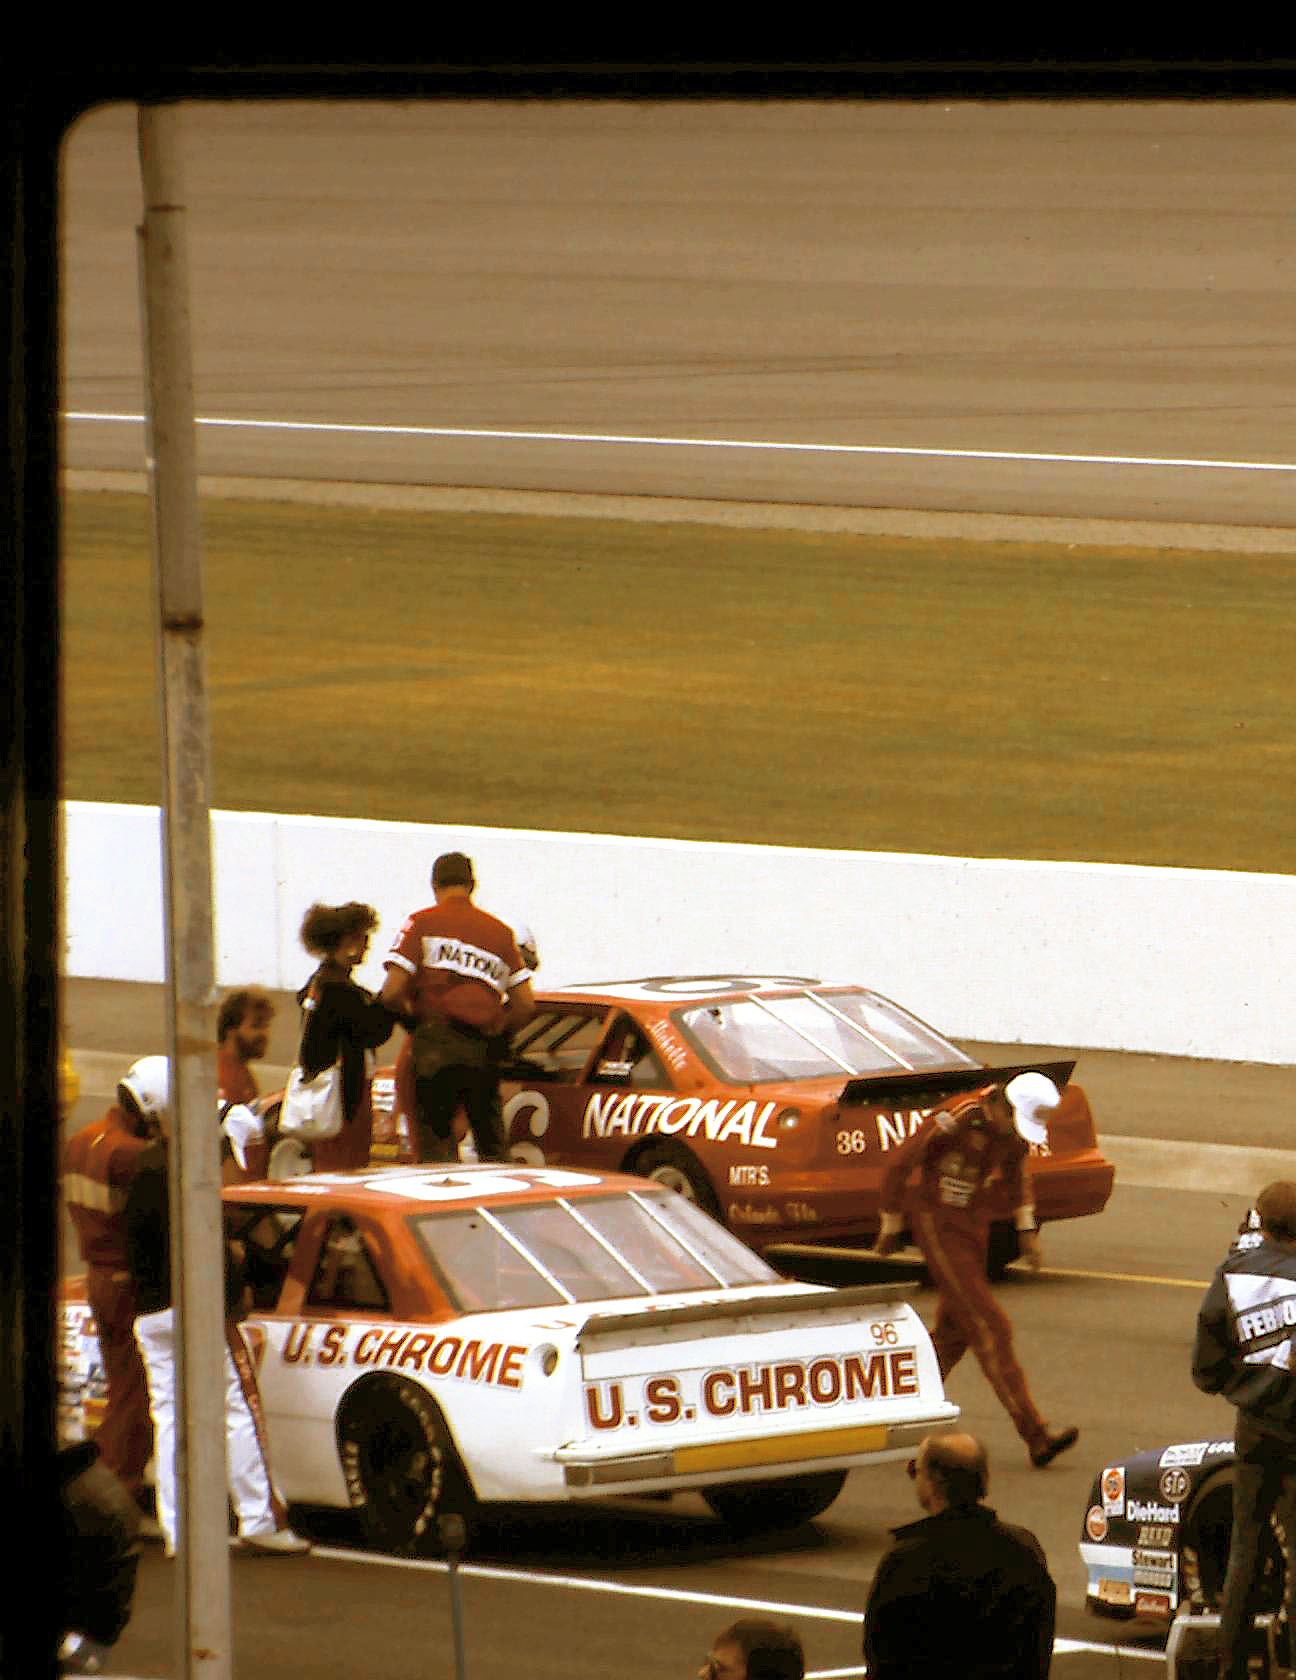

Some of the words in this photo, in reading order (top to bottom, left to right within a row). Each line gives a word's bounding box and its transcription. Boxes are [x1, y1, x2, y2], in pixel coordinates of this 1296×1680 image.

[583, 1093, 778, 1148] NATIONAL
[836, 1130, 867, 1154] 36
[869, 1322, 899, 1347] 96
[282, 1324, 348, 1364] U.S.
[353, 1328, 528, 1388] CHROME
[585, 1378, 697, 1430] U.S.
[702, 1351, 918, 1417] CHROME
[1163, 1471, 1187, 1495] STP
[1127, 1500, 1180, 1522] DieHard
